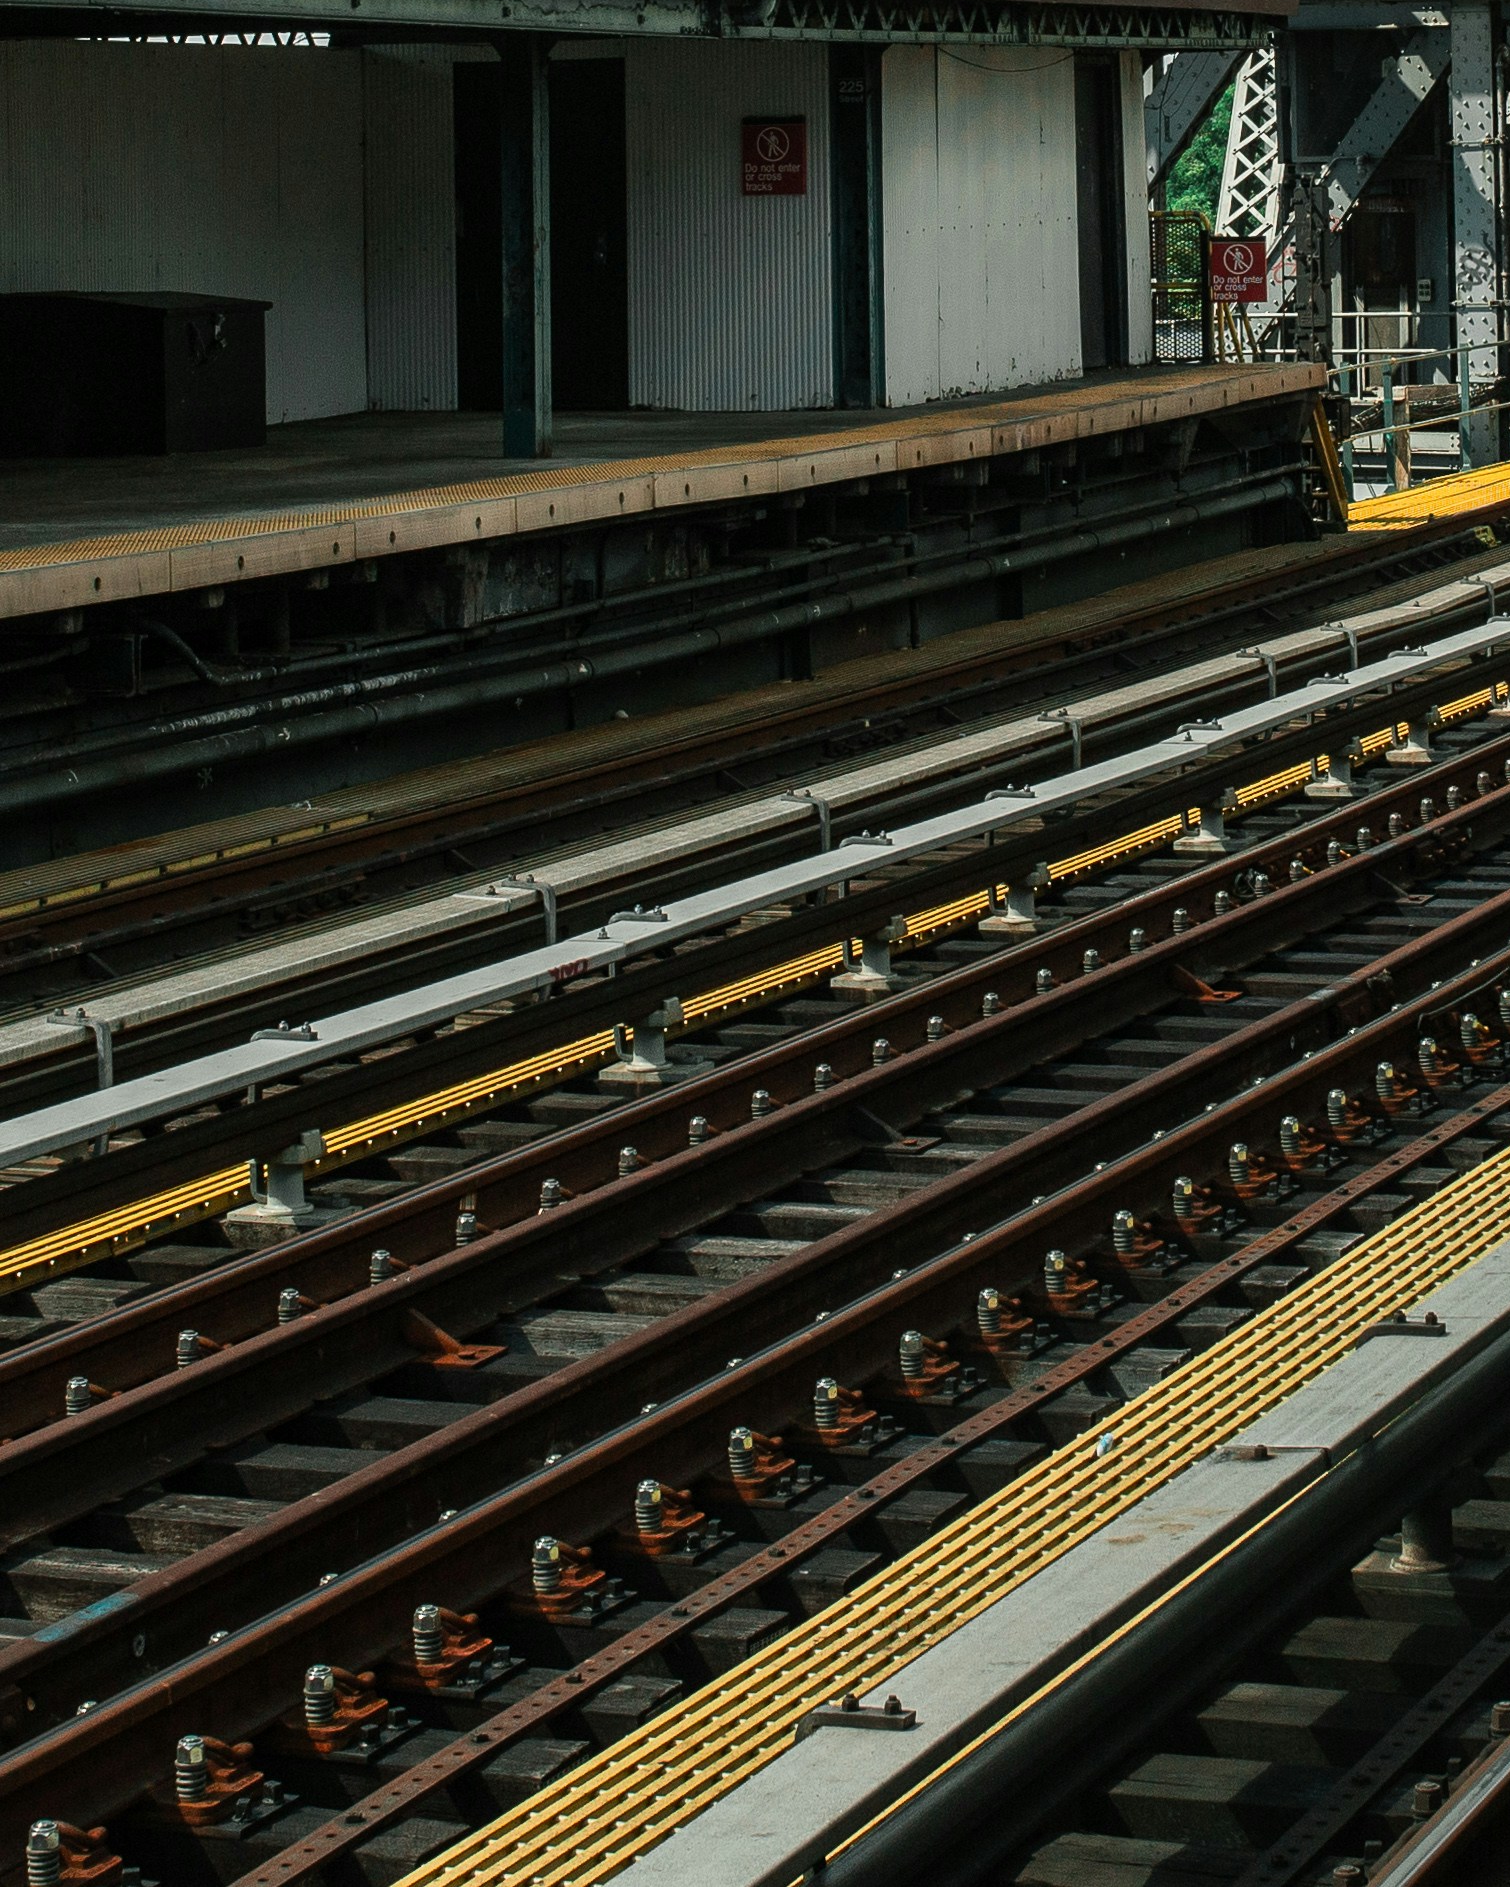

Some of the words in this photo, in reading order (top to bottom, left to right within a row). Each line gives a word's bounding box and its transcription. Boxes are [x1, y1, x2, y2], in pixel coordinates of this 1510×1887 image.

[745, 163, 758, 172] Do
[761, 163, 775, 172] not
[778, 163, 801, 172] enter
[745, 173, 755, 181] or
[758, 173, 782, 181] cross
[746, 182, 773, 191] tracks
[1213, 275, 1224, 283] Do
[1227, 275, 1240, 283] not
[1214, 292, 1238, 300] tracks
